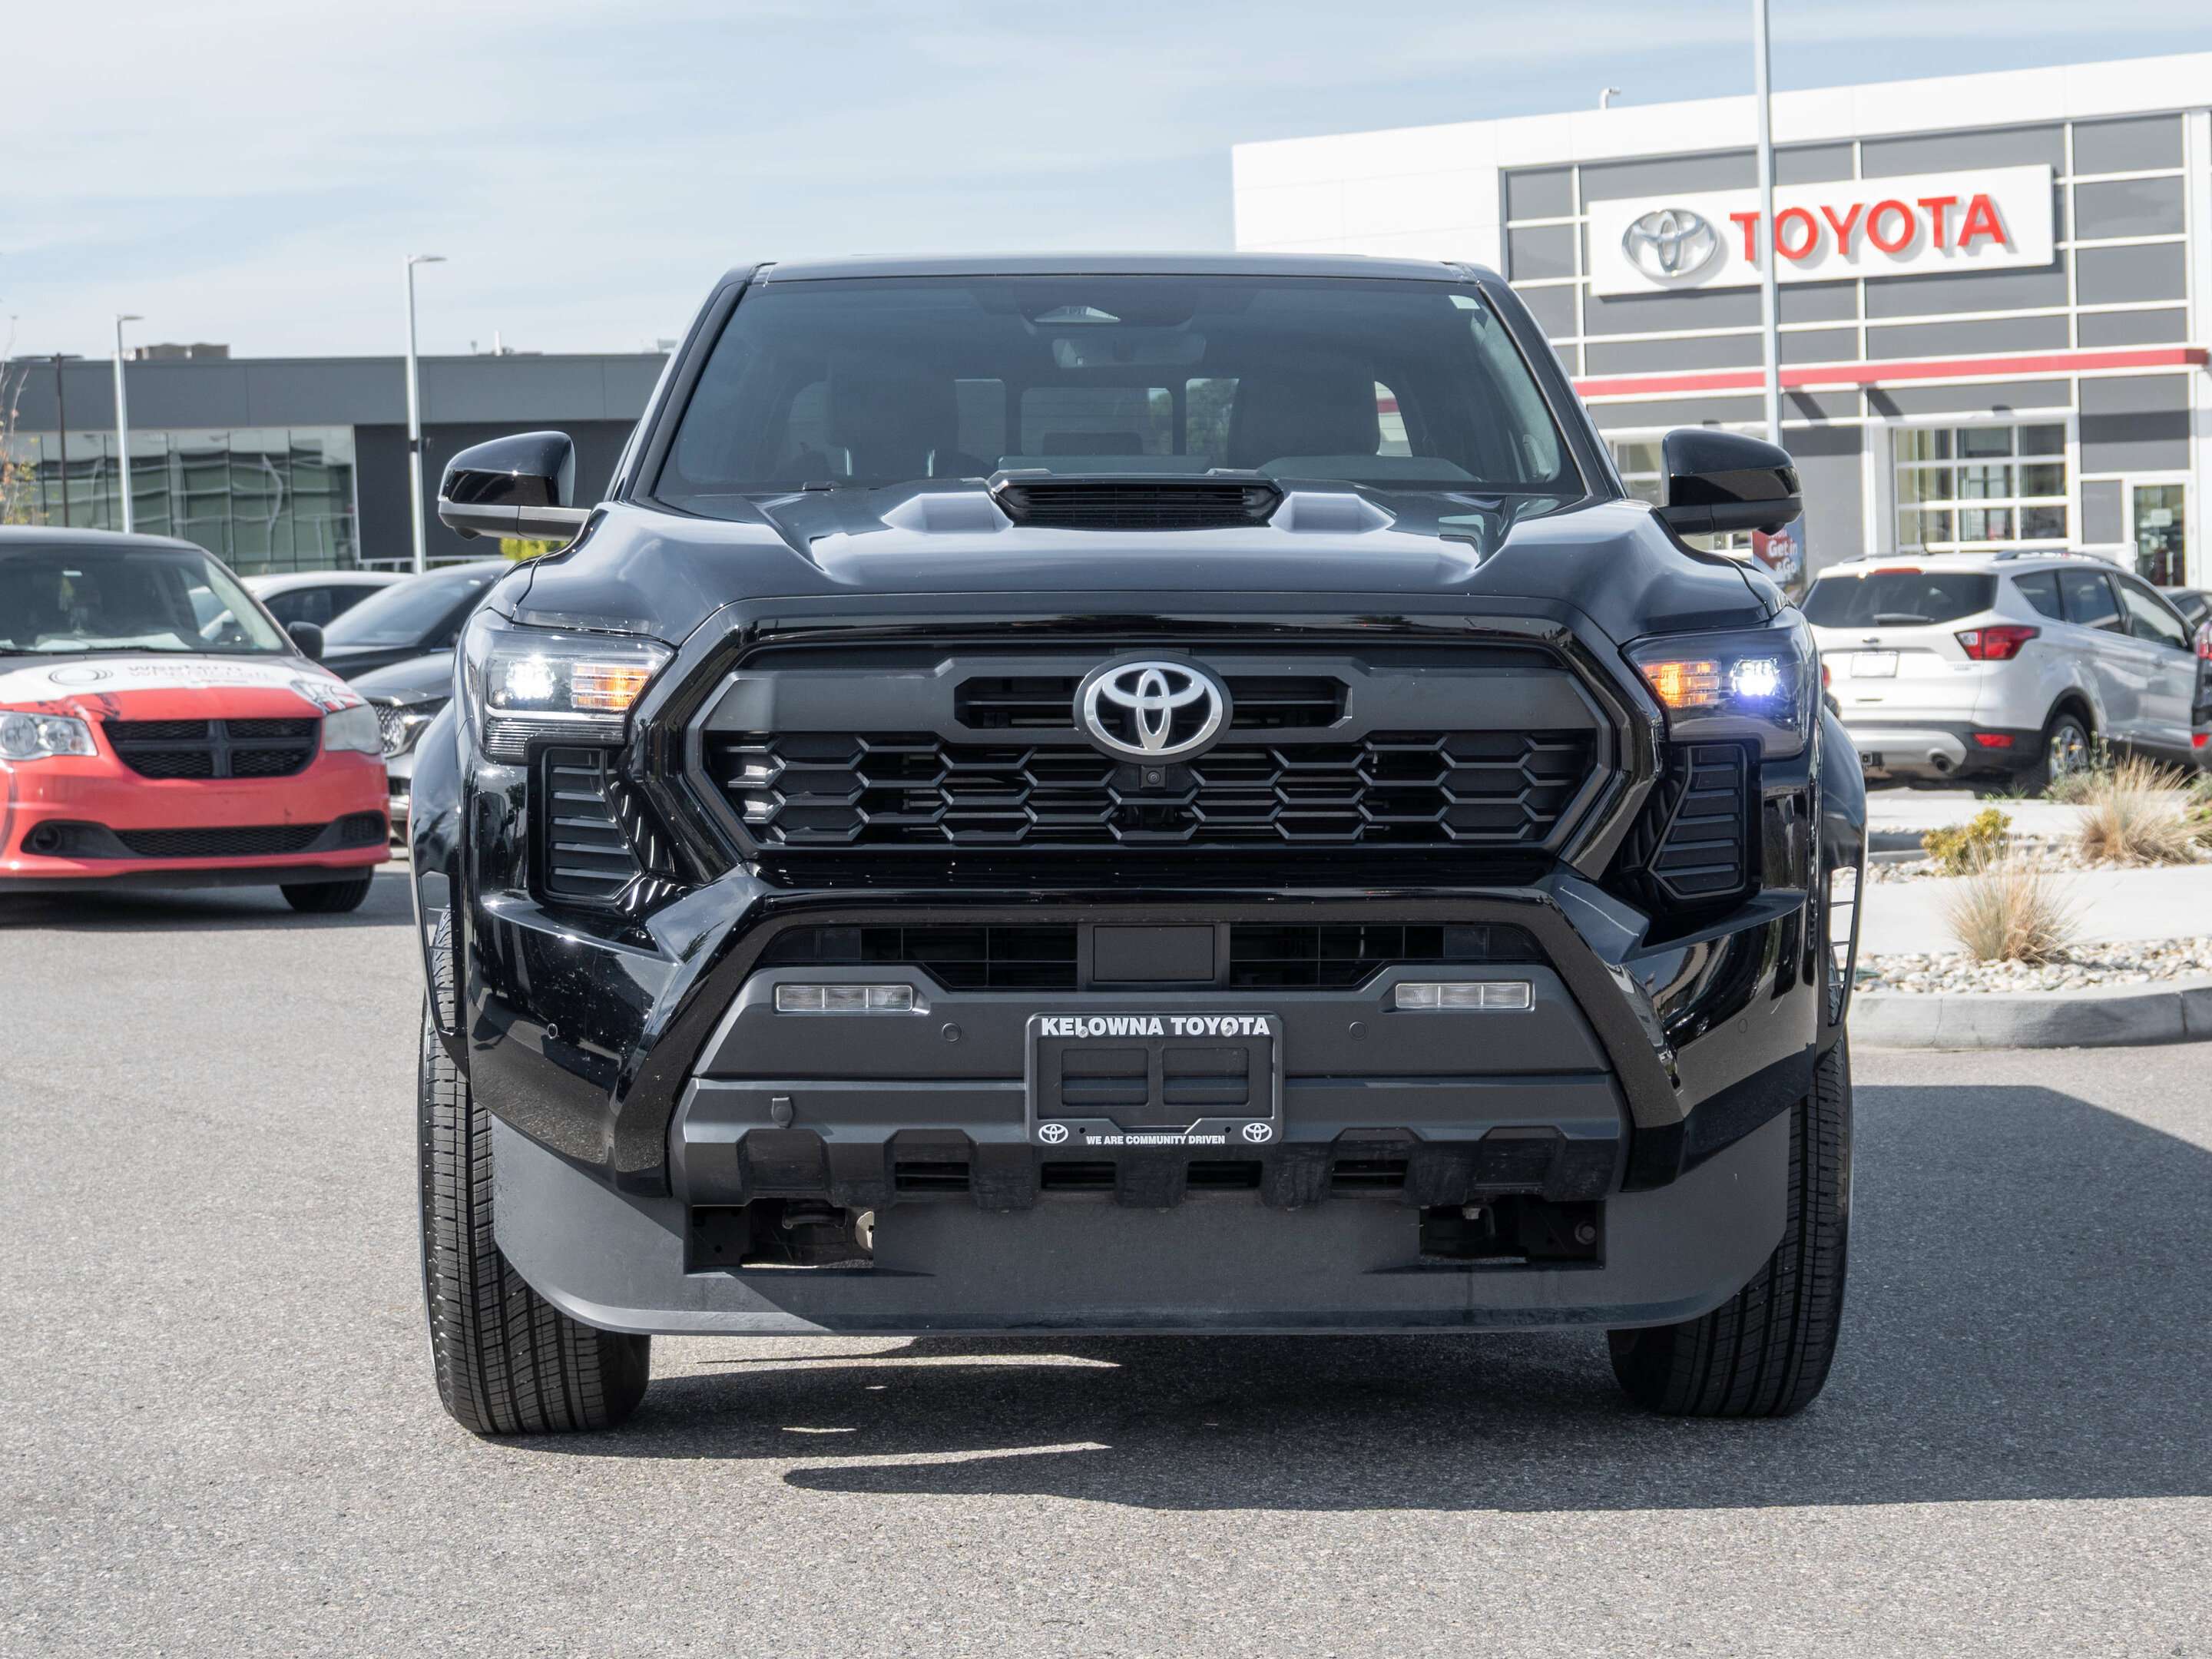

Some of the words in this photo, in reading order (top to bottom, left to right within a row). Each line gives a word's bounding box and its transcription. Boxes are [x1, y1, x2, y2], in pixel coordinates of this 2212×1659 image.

[1730, 194, 2007, 262] TOYOTA
[1768, 539, 1788, 558] Get
[1041, 1017, 1164, 1036] KELOWNA
[1171, 1016, 1270, 1036] TOYOTA
[1086, 1135, 1102, 1144] WE
[1104, 1135, 1124, 1144] ARE
[1125, 1135, 1187, 1144] COMMUNITY
[1188, 1134, 1226, 1144] DRIVEN
